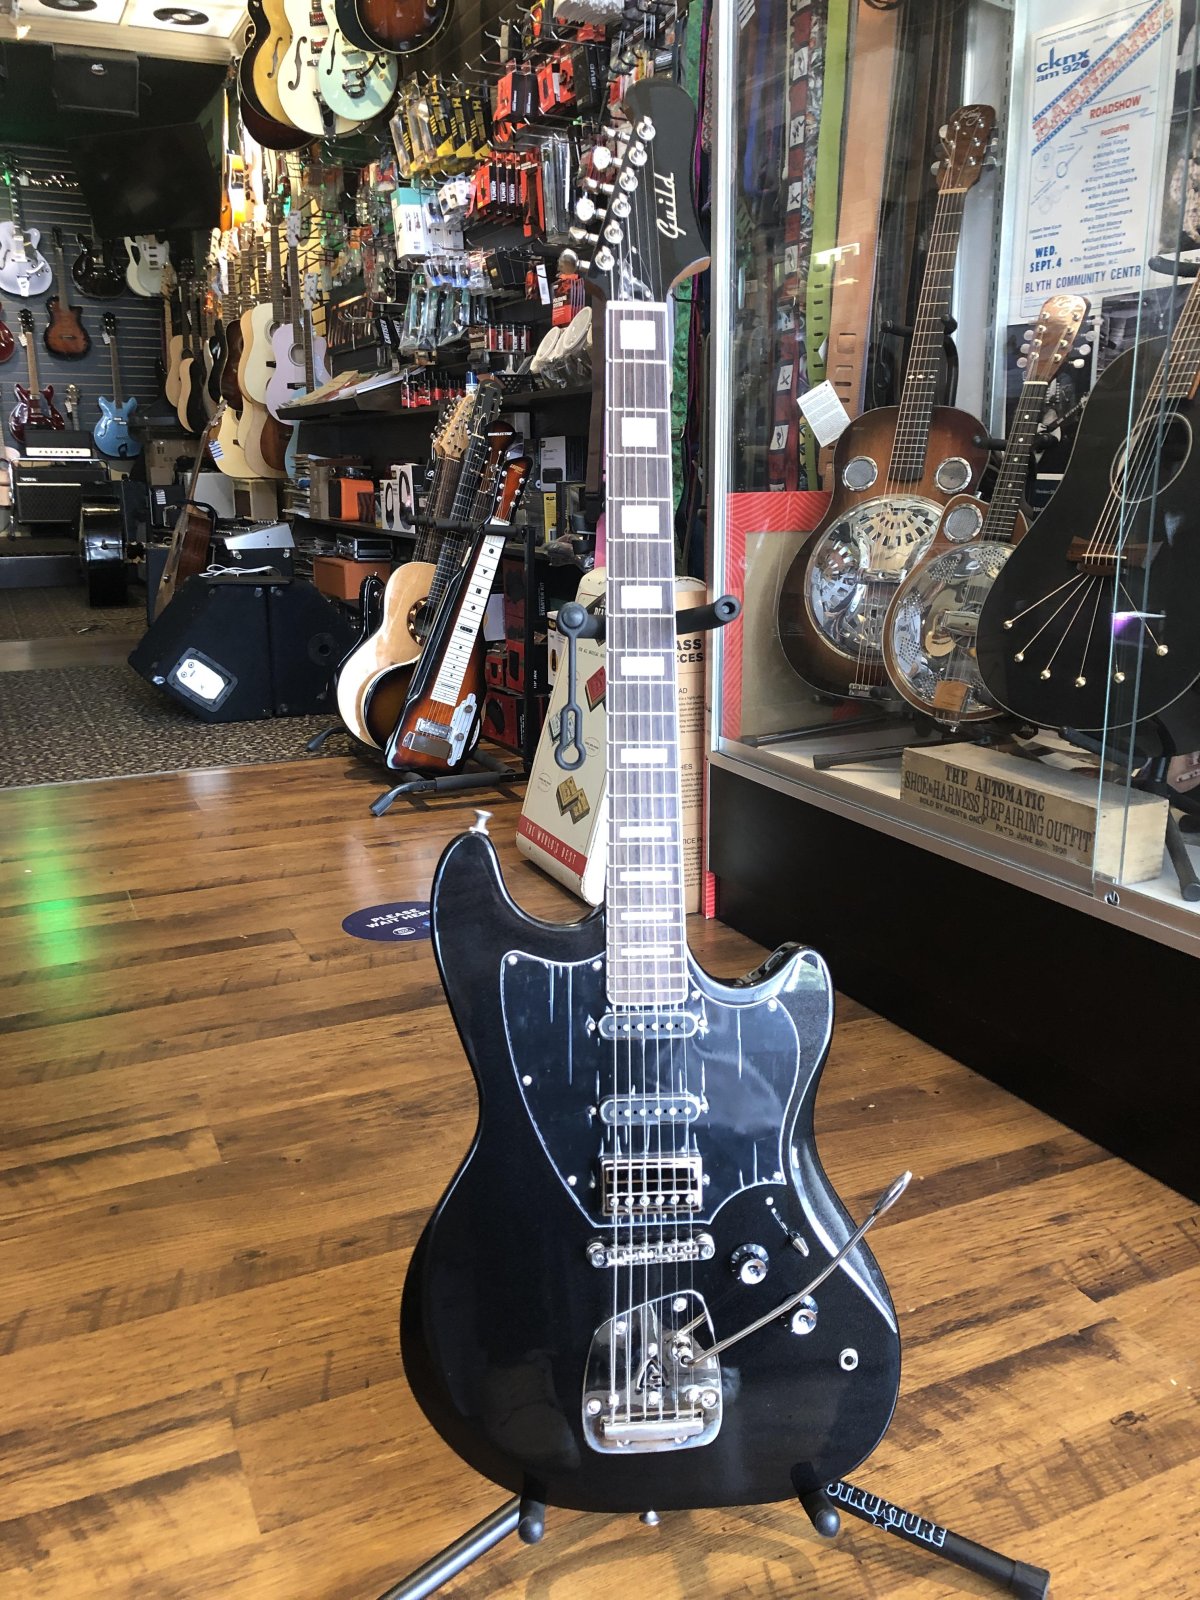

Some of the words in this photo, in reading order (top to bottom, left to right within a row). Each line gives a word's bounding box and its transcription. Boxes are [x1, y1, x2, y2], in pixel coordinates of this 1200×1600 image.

[1036, 46, 1090, 73] cknx
[1036, 70, 1059, 82] am
[1089, 94, 1142, 119] ROADSHOW
[654, 172, 687, 239] Guild
[1035, 245, 1058, 258] WED.
[1029, 260, 1055, 273] SEPT.
[1056, 257, 1062, 267] 4
[1025, 279, 1052, 293] BLYTH
[1055, 270, 1106, 289] COMMUNITY
[944, 764, 968, 787] THE
[975, 775, 1045, 812] AUTOMATIC
[935, 802, 943, 811] BY
[968, 814, 986, 825] ONLY
[982, 797, 1044, 836] REPAIRING
[1046, 819, 1092, 852] OUTFIT
[525, 821, 536, 837] THE
[537, 830, 560, 855] WORLD'S
[561, 847, 577, 865] BEST
[1016, 832, 1033, 843] JUNE
[365, 917, 399, 928] WAIT
[370, 908, 420, 922] PLEASE
[826, 1480, 948, 1548] STRUKTURE
